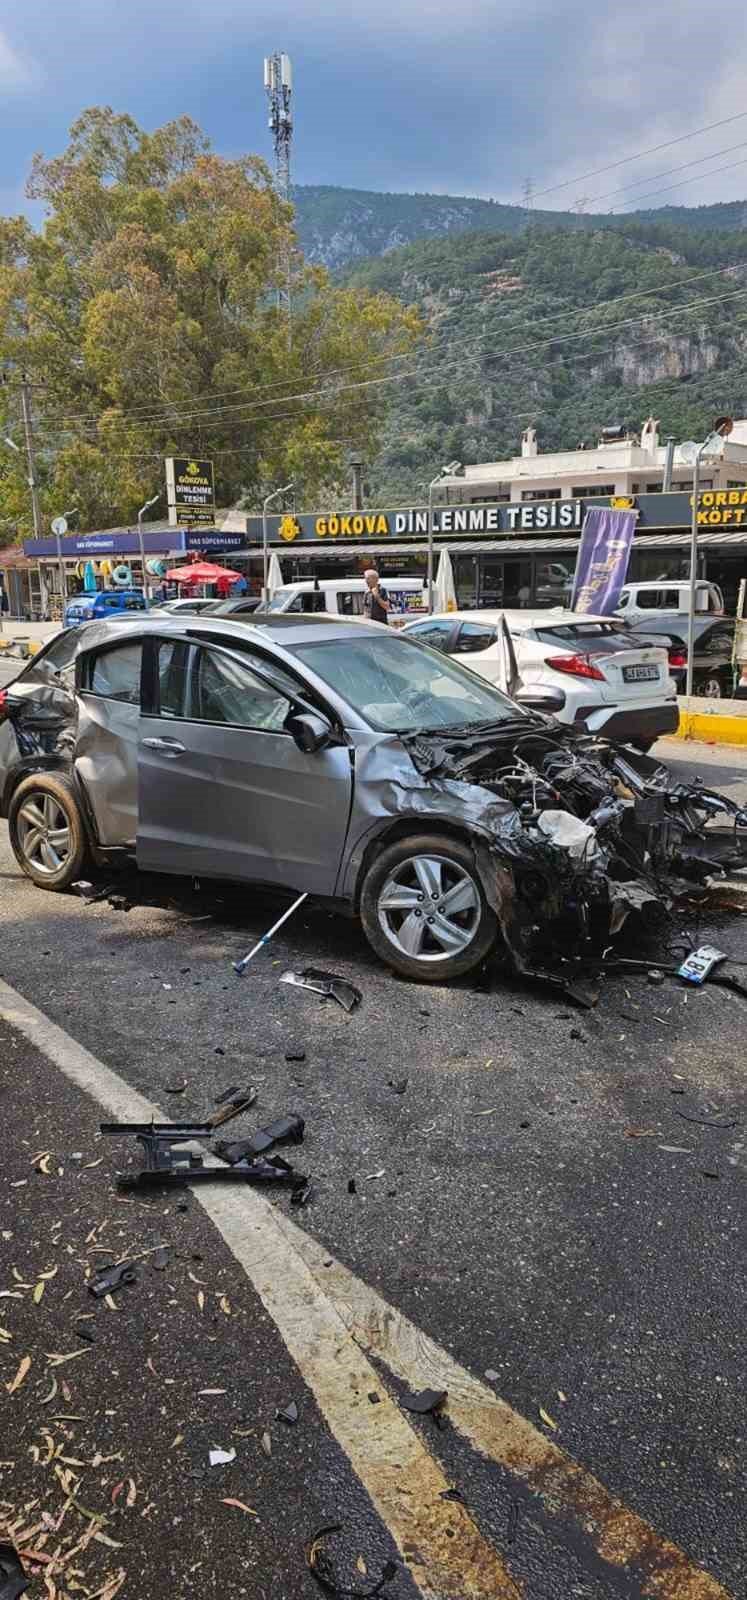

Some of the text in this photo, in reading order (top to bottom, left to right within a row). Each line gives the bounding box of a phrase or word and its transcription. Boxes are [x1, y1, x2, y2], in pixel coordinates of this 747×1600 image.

[178, 474, 209, 485] GÖKOVA
[176, 485, 213, 495] DİNLENME
[183, 495, 207, 504] TESİSİ
[315, 500, 581, 536] GÖKOVA DİNLENME TESİSİ
[202, 536, 241, 546] SÜPERMARKET
